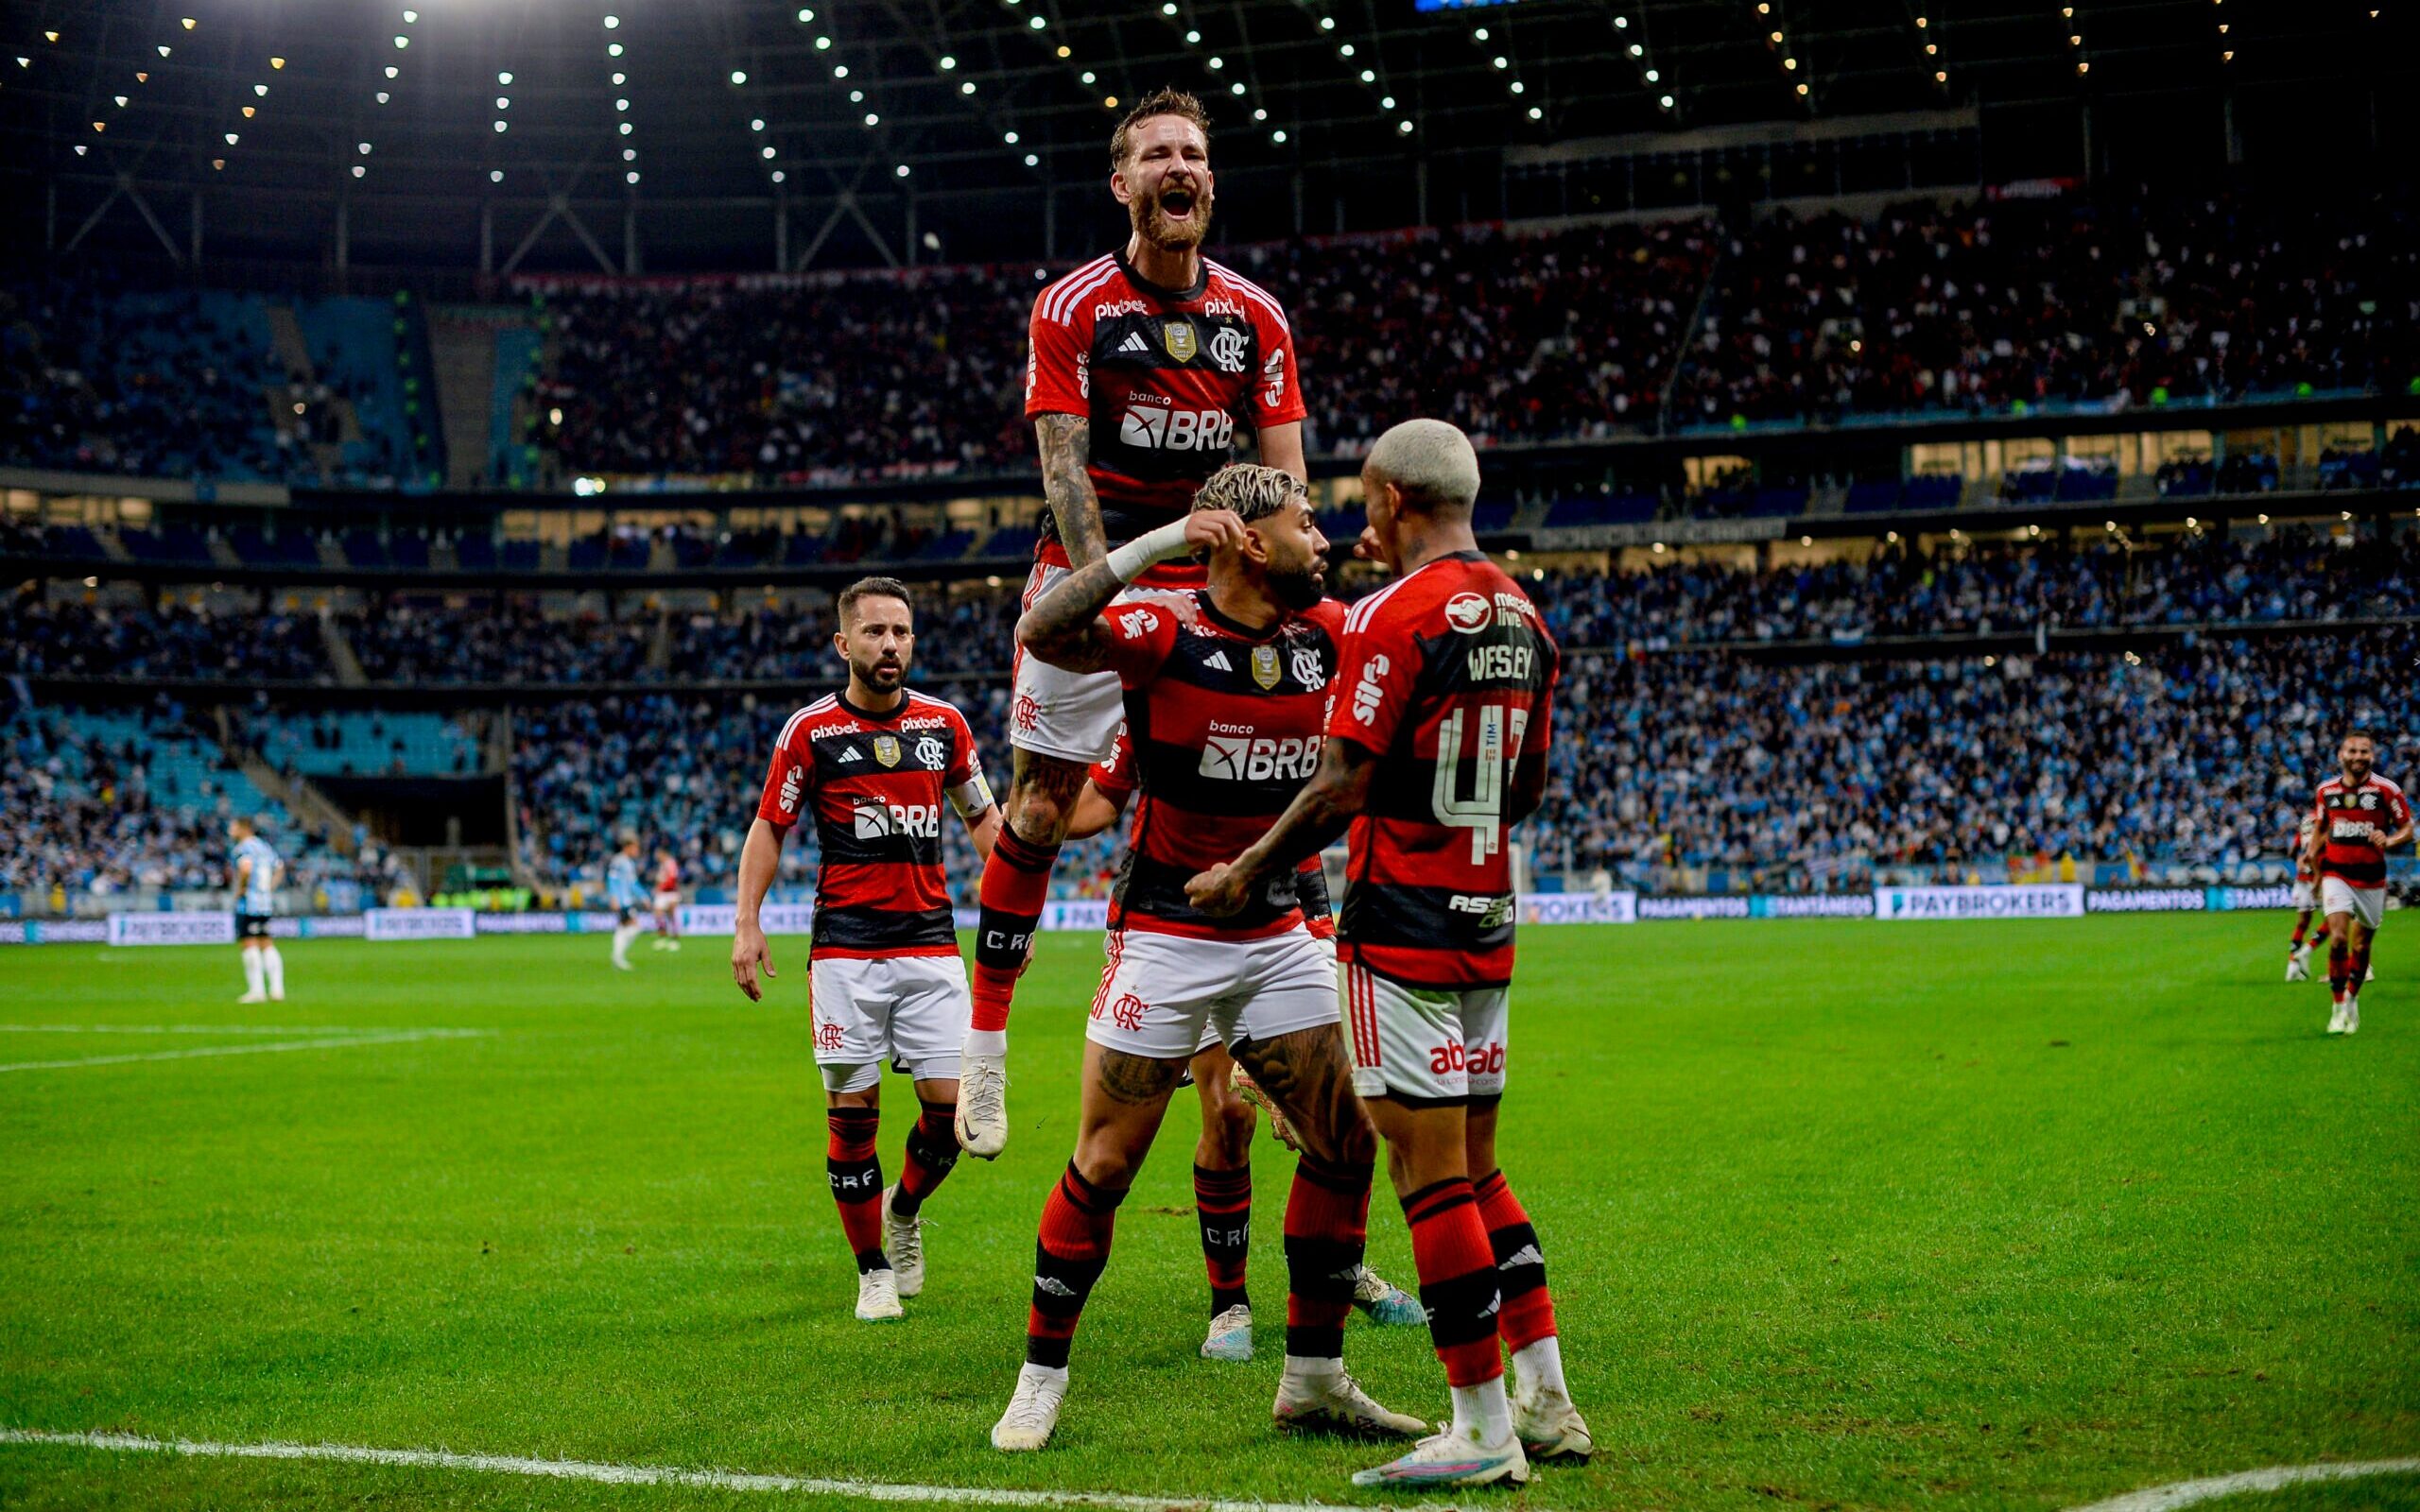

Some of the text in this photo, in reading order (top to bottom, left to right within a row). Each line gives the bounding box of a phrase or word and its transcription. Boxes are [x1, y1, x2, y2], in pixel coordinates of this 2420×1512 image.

[1095, 299, 1149, 321] pixbet
[1129, 390, 1171, 406] banco
[1165, 408, 1234, 452] BRB
[1467, 644, 1533, 681] WESLEY
[810, 719, 861, 743] pixbet
[900, 714, 946, 733] pixbet
[1209, 719, 1254, 734] banco
[1486, 723, 1497, 747] TIM
[1247, 734, 1322, 782] BRB
[889, 804, 939, 838] BRB
[1910, 892, 2070, 915] PAYBROKERS
[2087, 888, 2204, 912] PAGAMENTOS
[1429, 1039, 1465, 1075] ab
[1466, 1041, 1506, 1075] ab
[827, 1168, 875, 1190] CRF
